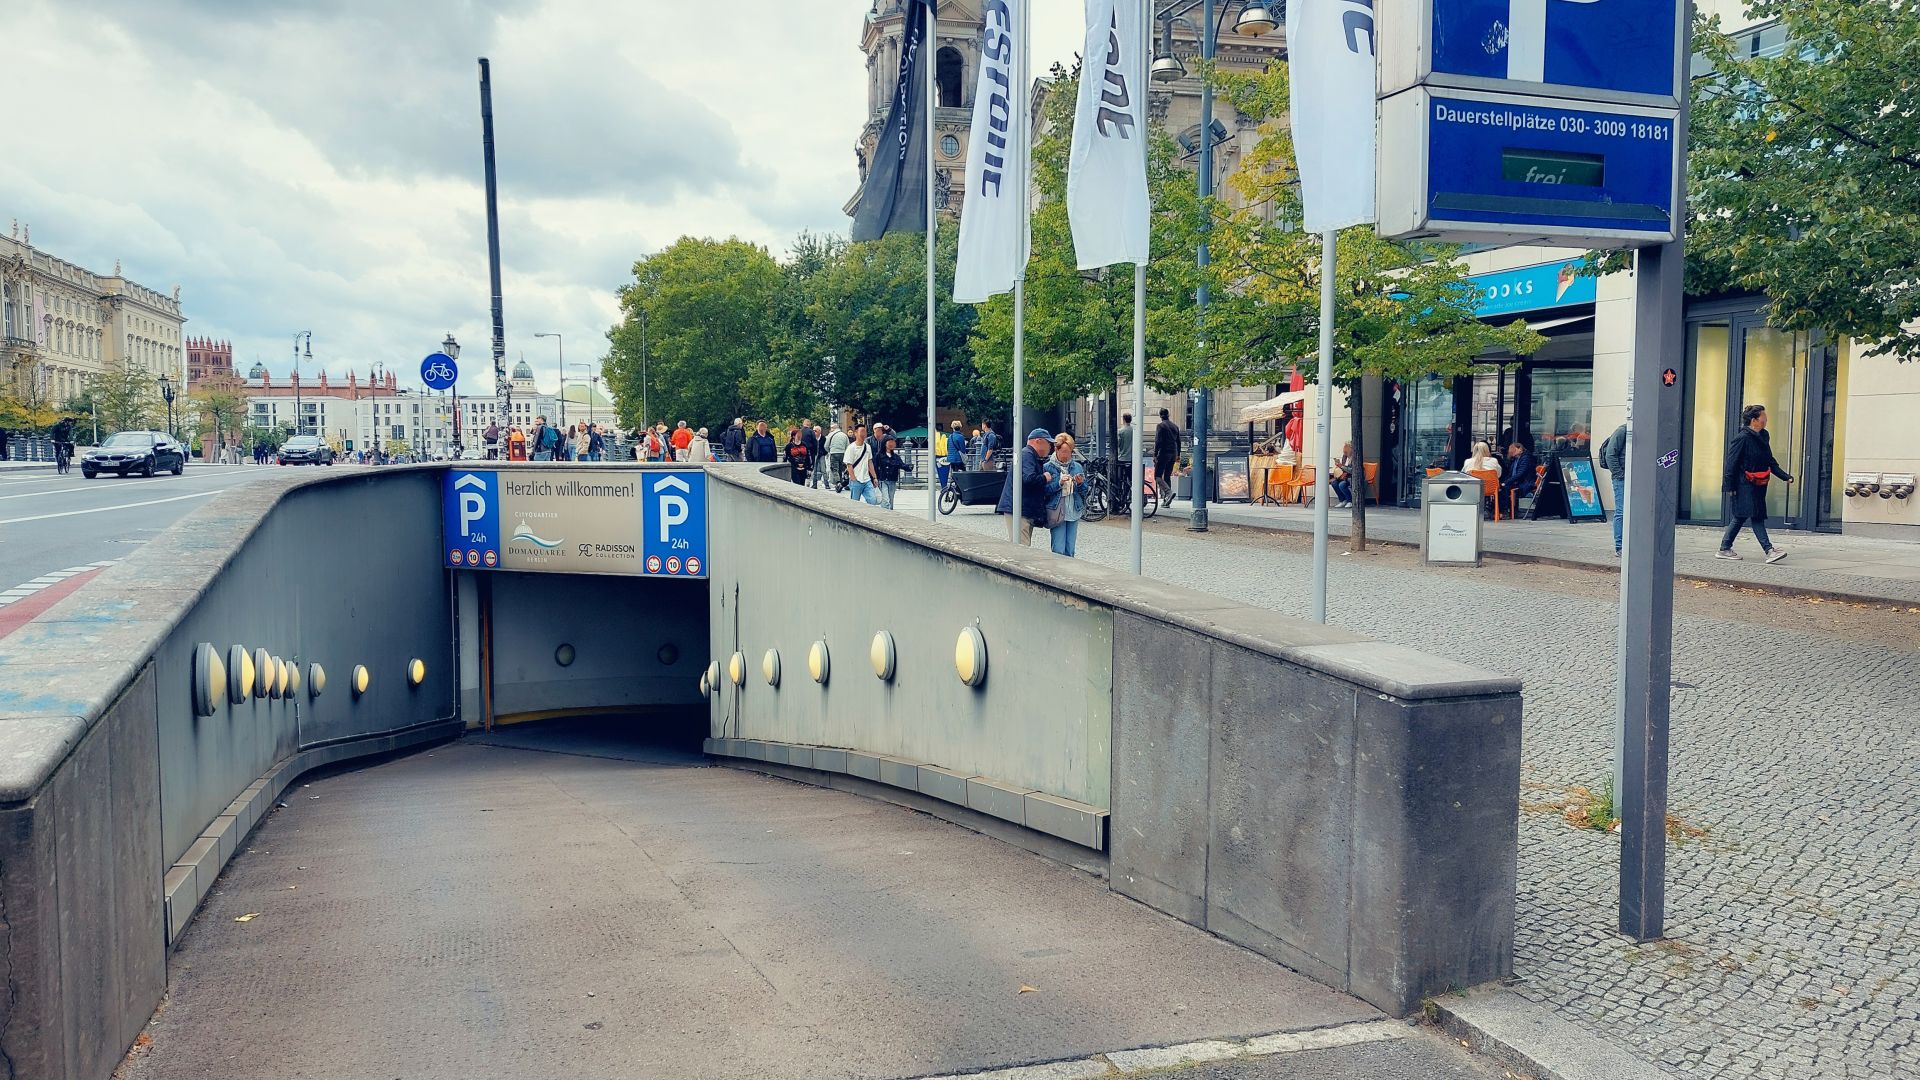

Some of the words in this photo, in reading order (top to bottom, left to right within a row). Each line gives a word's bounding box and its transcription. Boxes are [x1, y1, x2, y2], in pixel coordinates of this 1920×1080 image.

[1436, 104, 1556, 131] Dauerstellplätze
[1560, 116, 1590, 133] 030-
[1594, 120, 1626, 137] 3009
[1630, 123, 1668, 140] 18181
[1524, 166, 1566, 184] frei
[506, 481, 552, 497] Herzlich
[556, 481, 635, 498] willkommen!
[459, 492, 486, 537] P
[659, 495, 689, 542] P
[471, 532, 487, 543] 24h
[671, 538, 689, 549] 24h
[595, 544, 635, 552] RADISSON
[669, 561, 678, 569] 10
